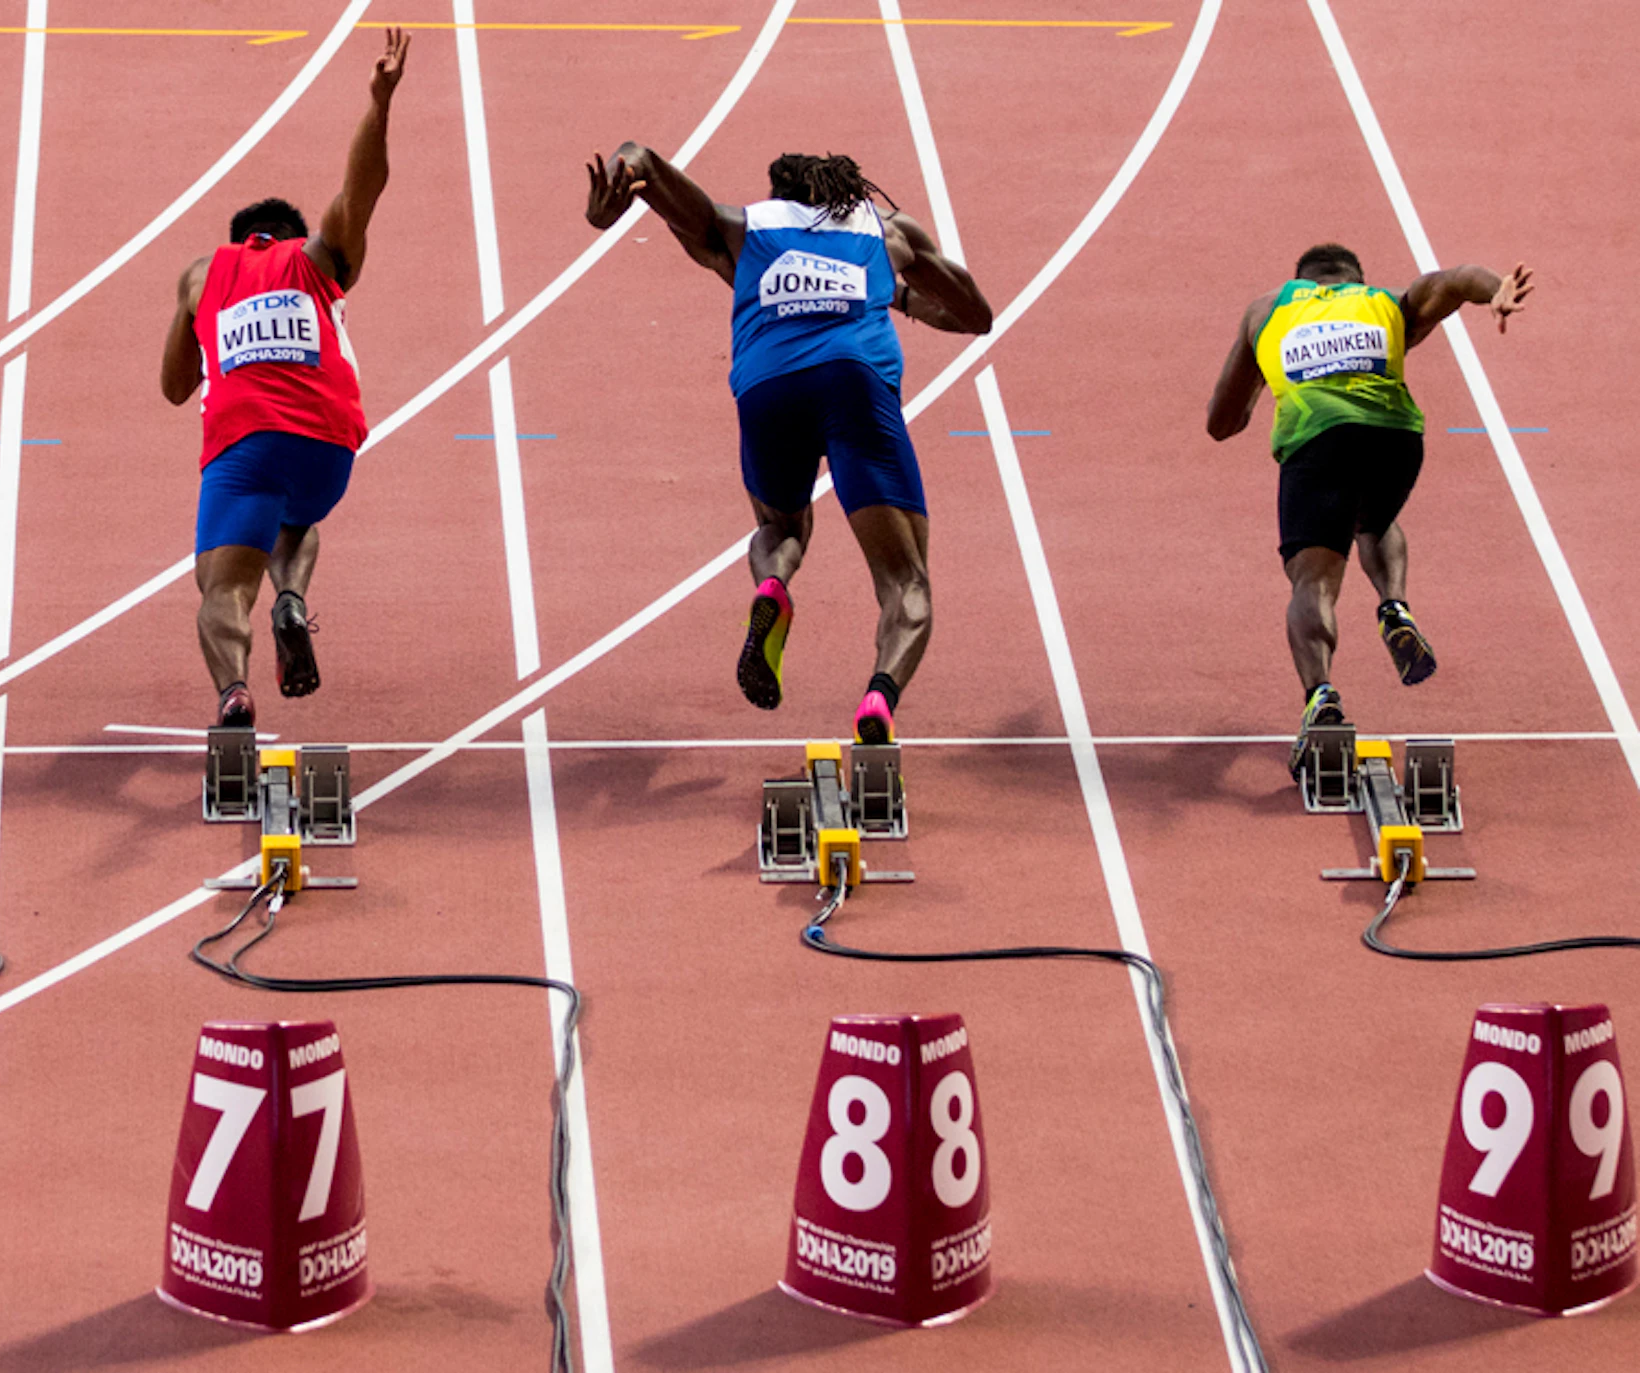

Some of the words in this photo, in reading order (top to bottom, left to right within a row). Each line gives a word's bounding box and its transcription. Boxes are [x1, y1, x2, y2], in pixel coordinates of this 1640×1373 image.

[796, 255, 849, 277] TDK
[248, 294, 301, 312] TDK
[777, 300, 850, 317] DOHA2019
[222, 317, 313, 351] WILLIE
[1311, 322, 1355, 334] TD
[234, 348, 306, 366] DOHA2019
[1285, 330, 1383, 365] MA'UNIKENI
[1302, 359, 1374, 379] DOHA2019
[199, 1035, 264, 1070] MONDO
[288, 1033, 341, 1070] MONDO
[830, 1030, 901, 1066] MONDO
[1473, 1019, 1541, 1055] MONDO
[185, 1071, 268, 1213] 7
[290, 1067, 347, 1223] 7
[820, 1074, 893, 1212] 8
[930, 1070, 981, 1208] 8
[1461, 1061, 1534, 1198] 9
[1568, 1059, 1624, 1201] 9
[171, 1234, 263, 1287] DOHA2019
[797, 1227, 896, 1282] DOHA2019
[1440, 1215, 1534, 1270] DOHA2019
